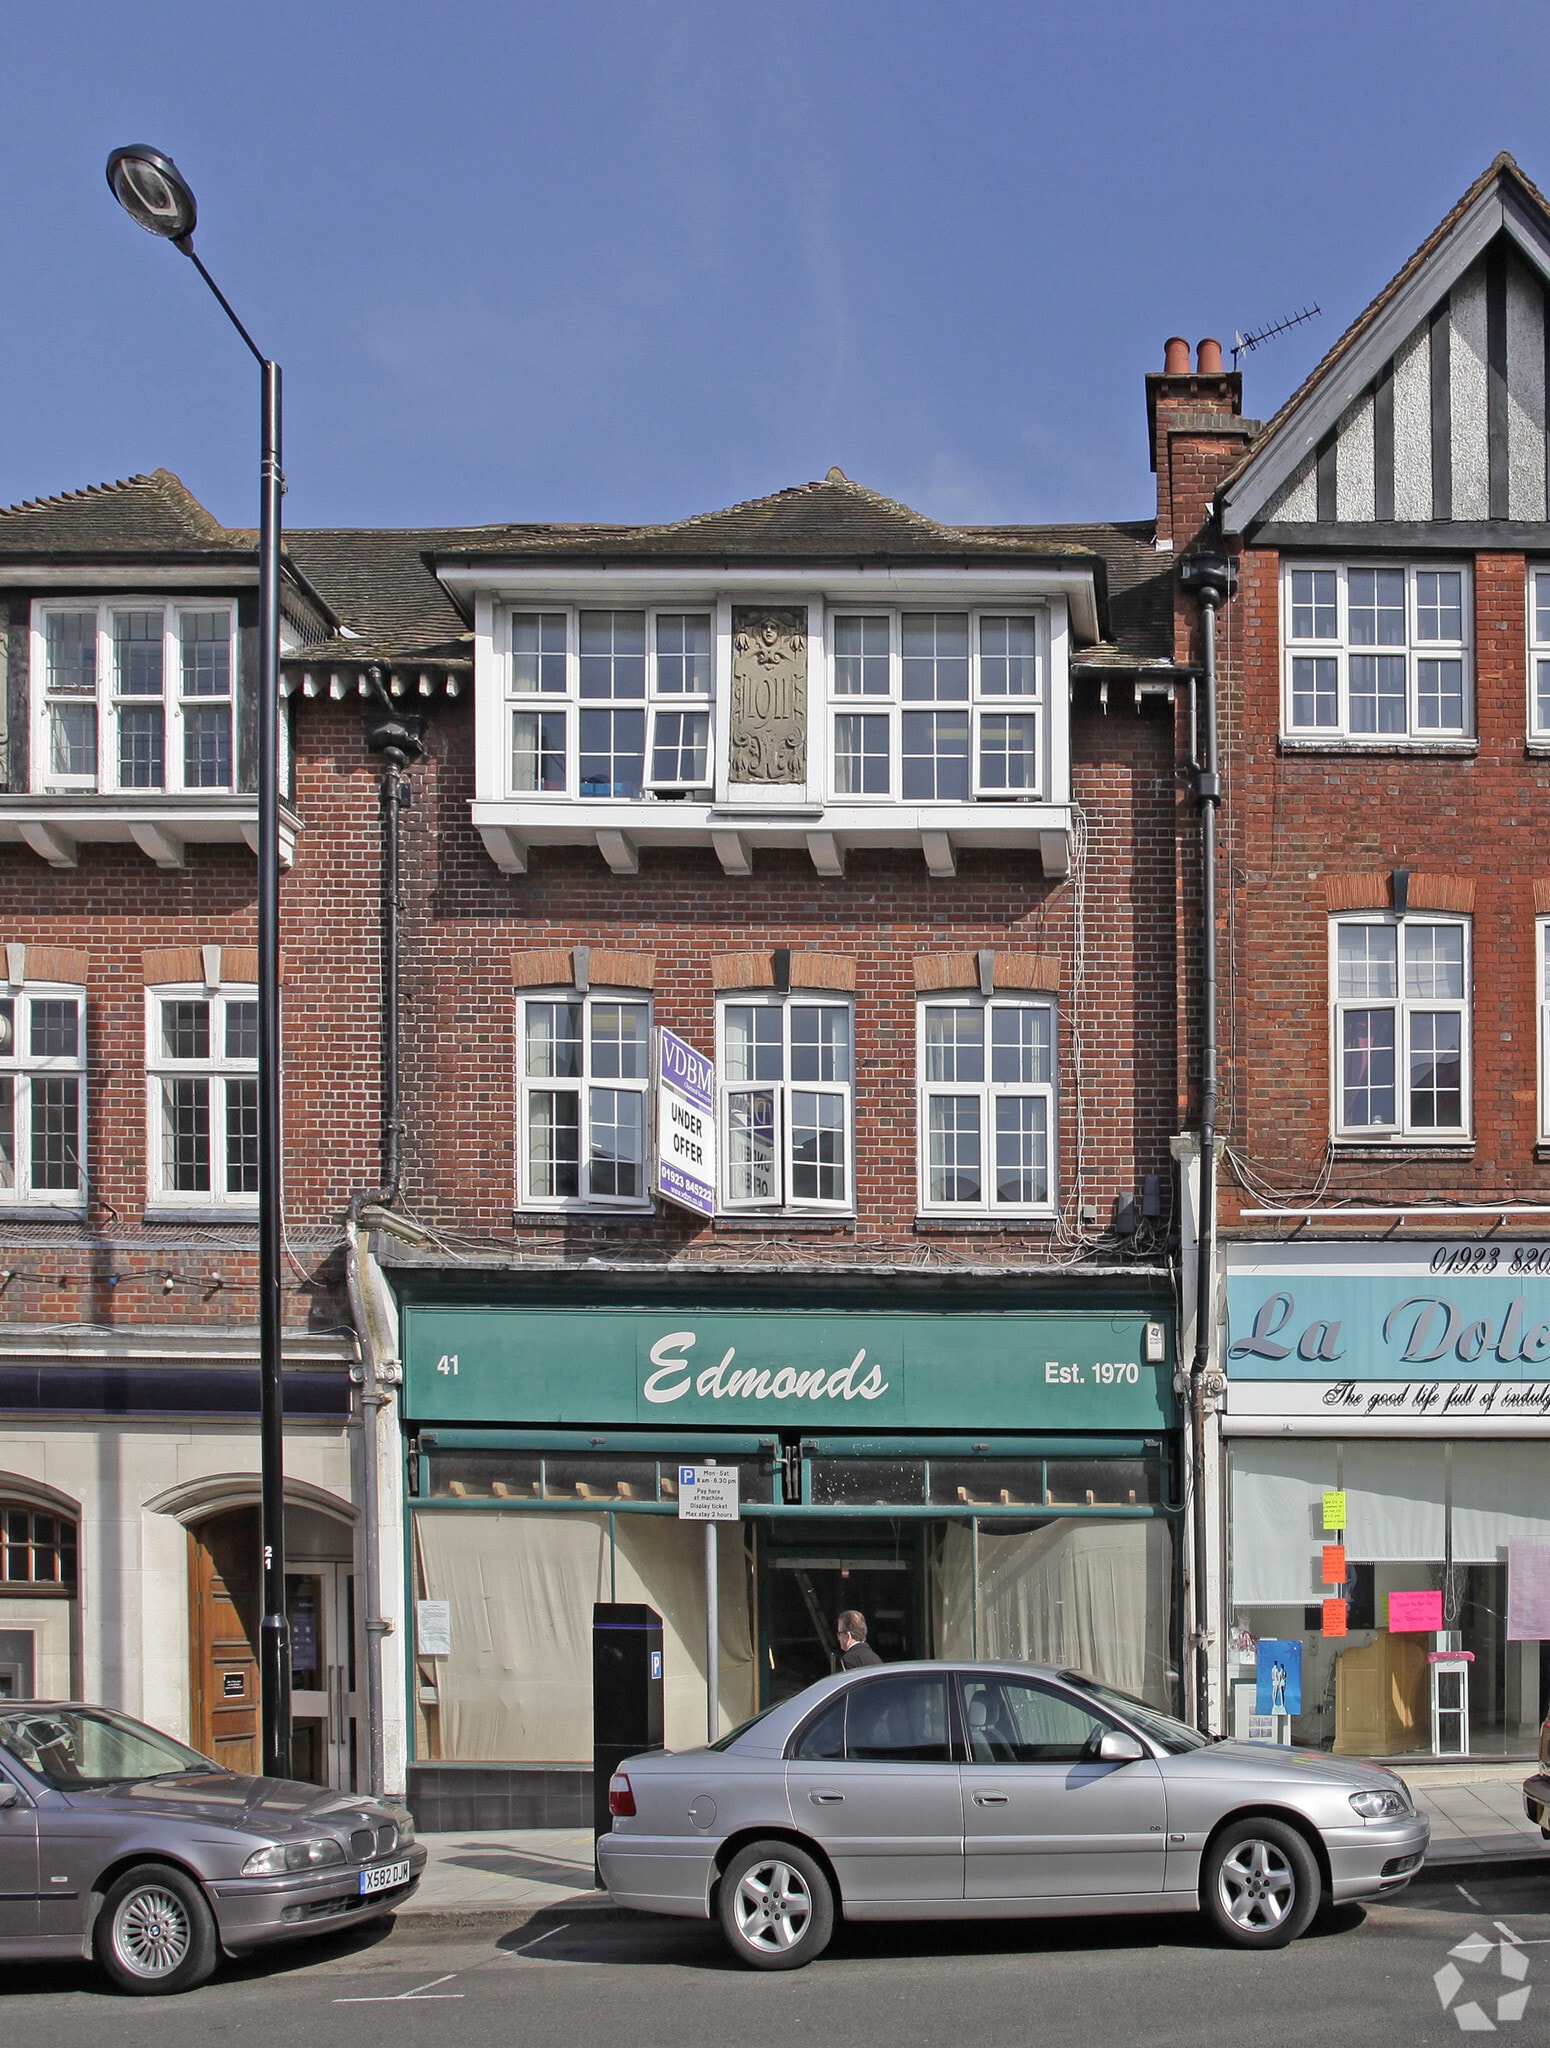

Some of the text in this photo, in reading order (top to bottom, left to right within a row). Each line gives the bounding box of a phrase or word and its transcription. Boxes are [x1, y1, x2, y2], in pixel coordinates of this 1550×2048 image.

[663, 1036, 711, 1096] VDBM
[671, 1102, 702, 1138] UNDER
[673, 1134, 703, 1166] OFFER
[661, 1166, 712, 1202] 01923 845222
[1429, 1246, 1550, 1275] 01923 820
[1228, 1291, 1347, 1364] La
[437, 1354, 459, 1375] 41
[643, 1331, 889, 1404] Edmonds
[1045, 1361, 1139, 1384] Est. 1970
[1322, 1379, 1364, 1406] The
[1364, 1384, 1411, 1417] good
[1411, 1382, 1440, 1415] life
[1441, 1382, 1479, 1415] full
[1480, 1380, 1501, 1415] of
[684, 1470, 693, 1483] P
[653, 1656, 660, 1675] P
[367, 1868, 391, 1889] X582
